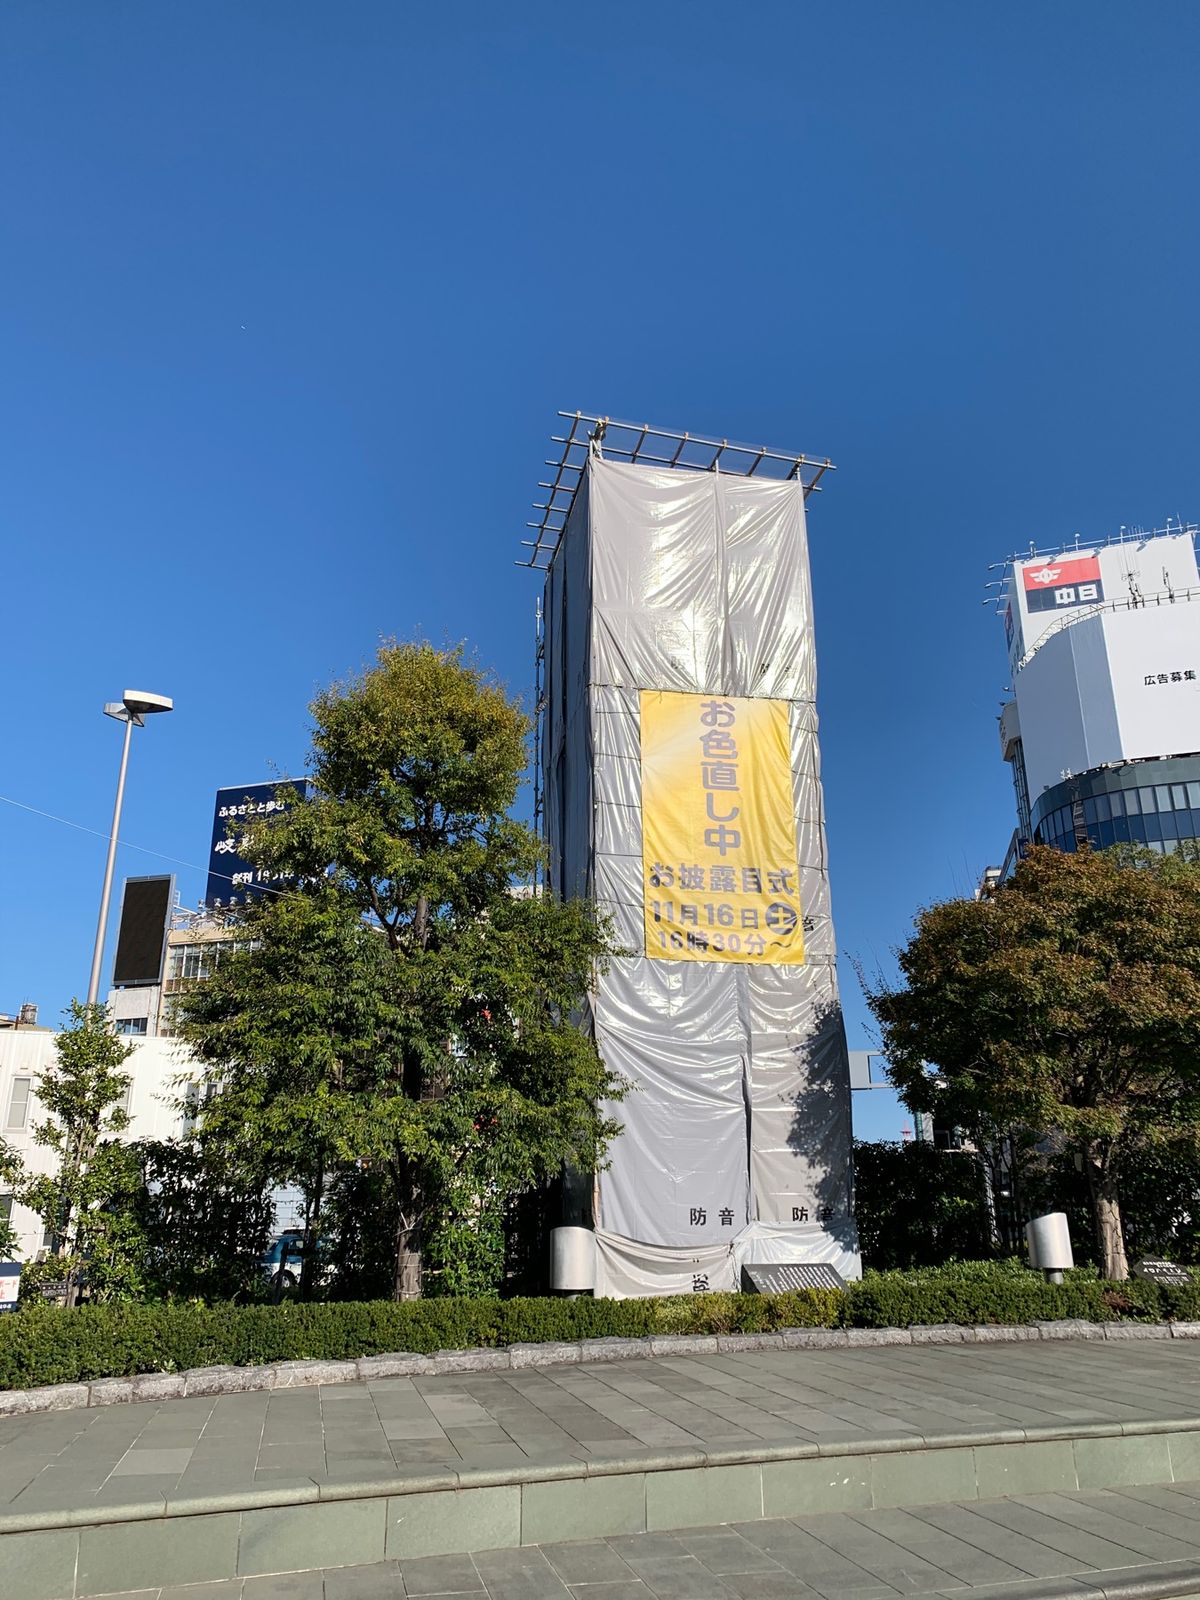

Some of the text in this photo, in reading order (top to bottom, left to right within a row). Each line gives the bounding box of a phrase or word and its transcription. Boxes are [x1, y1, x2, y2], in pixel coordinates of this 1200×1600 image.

[1055, 583, 1098, 605] 中日
[1143, 669, 1197, 687] 広告募集
[699, 700, 741, 856] お色直し中
[649, 862, 794, 895] お披露目式
[690, 1207, 735, 1226] 防音
